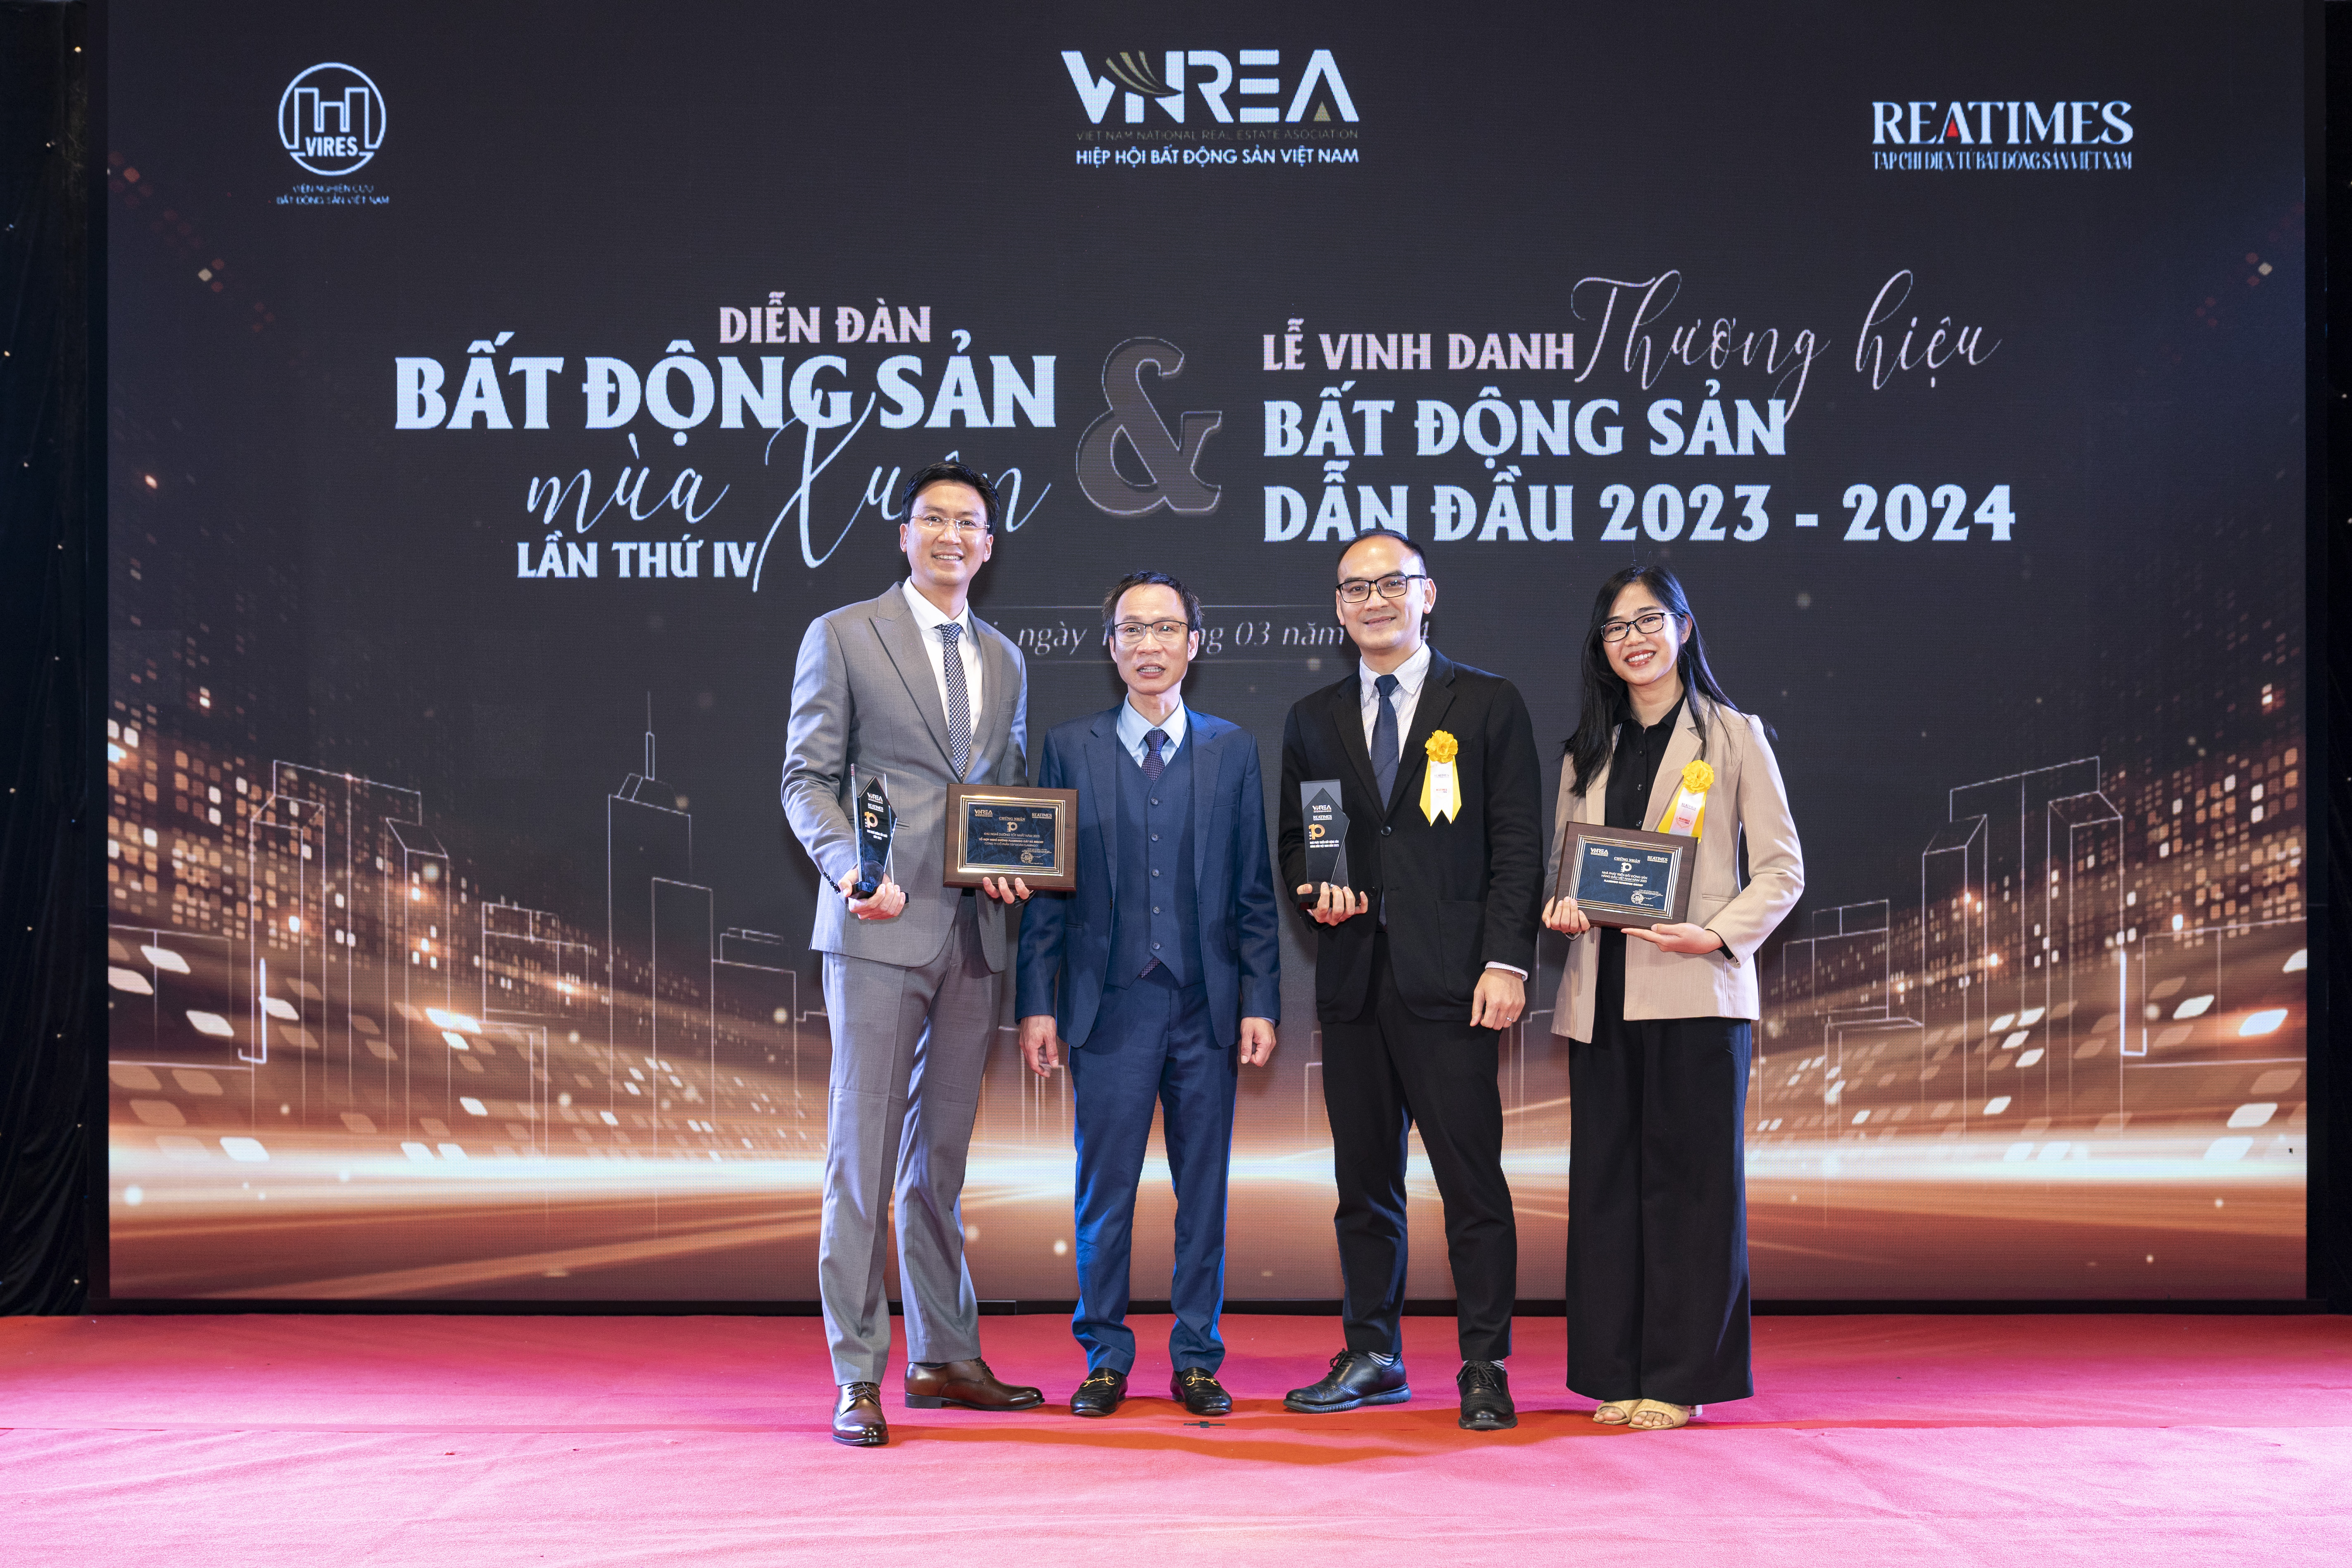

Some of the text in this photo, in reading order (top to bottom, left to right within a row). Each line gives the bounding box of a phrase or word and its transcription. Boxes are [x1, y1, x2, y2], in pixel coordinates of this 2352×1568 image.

[1061, 49, 1359, 124] VNREA
[305, 136, 359, 157] VIRES
[1137, 130, 1197, 140] NATIONAL
[1202, 130, 1233, 140] REAL
[1237, 130, 1279, 140] ESTATE
[1284, 130, 1358, 140] ASOCIATION
[1872, 101, 2133, 144] REATIMES
[1076, 144, 1360, 168] HIỆP HỘI BẤT ĐỘNG SẢN VIỆT NAM
[720, 291, 931, 343] DIỄN ĐÀN
[1263, 269, 2002, 423] LỄ VINH DANH Thương hiệu
[395, 329, 1056, 446] BẤT ĐỘNG SẢN
[1076, 336, 1222, 516] &
[1264, 379, 1786, 469] BẤT ĐỘNG SẢN
[527, 392, 1052, 592] mùa Xun
[1264, 460, 2016, 542] DẪN ĐẦU 2023 - 2024
[517, 530, 756, 578] LẦN THỨ IV
[1018, 621, 1088, 655] ngày
[1235, 622, 1271, 645] 03
[1282, 622, 1345, 645] năm
